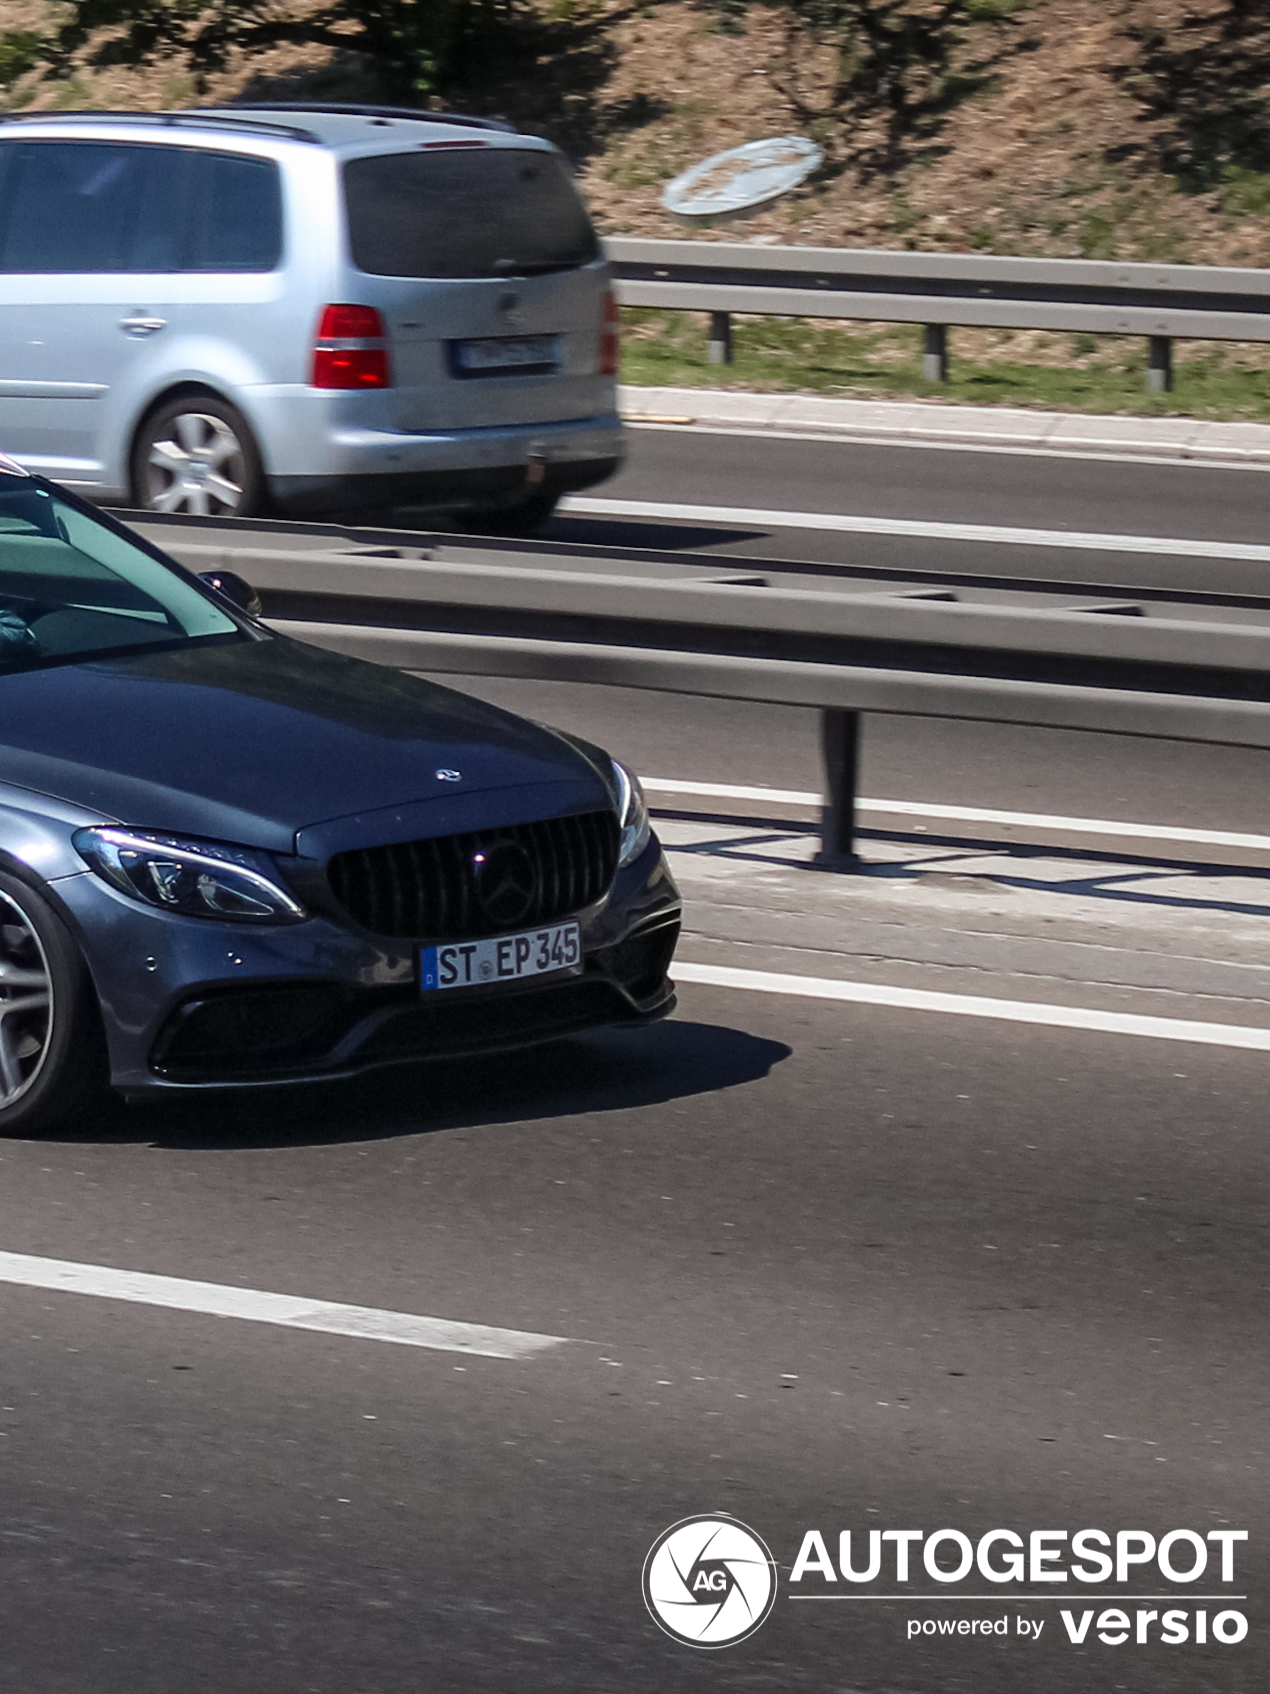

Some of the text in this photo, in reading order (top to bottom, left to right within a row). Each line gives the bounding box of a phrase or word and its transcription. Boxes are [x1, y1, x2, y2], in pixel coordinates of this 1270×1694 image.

[440, 945, 477, 985] ST
[497, 937, 529, 977] EP
[537, 927, 578, 970] 345
